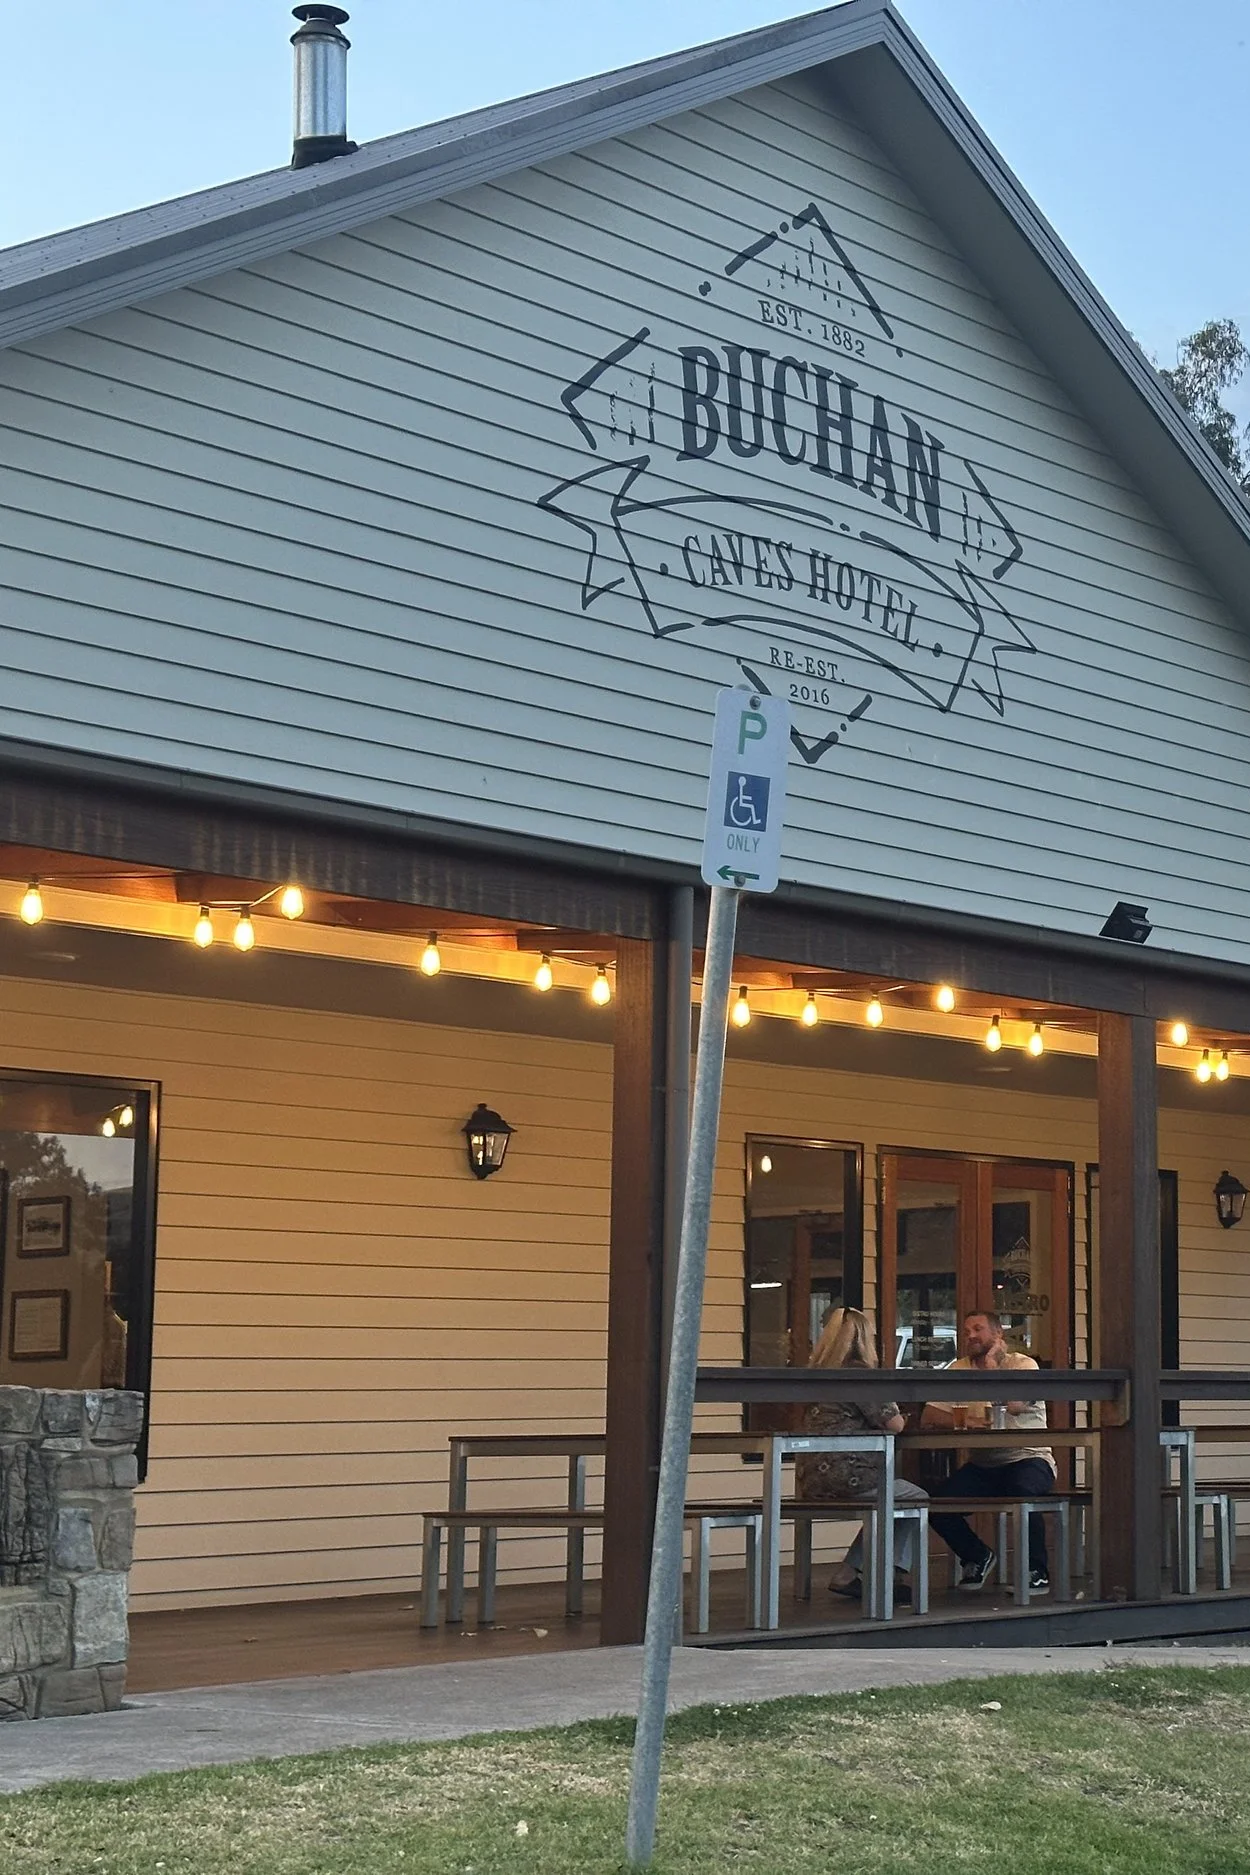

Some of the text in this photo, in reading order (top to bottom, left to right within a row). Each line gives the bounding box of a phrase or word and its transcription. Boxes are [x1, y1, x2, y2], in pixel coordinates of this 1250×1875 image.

[758, 300, 865, 357] EST. 1882
[677, 345, 945, 542] BUCHAN
[681, 534, 919, 652] CAVES HOTEL
[769, 646, 846, 683] RE-EST.
[789, 683, 830, 706] 2016
[738, 710, 767, 755] P
[726, 833, 761, 853] ONLY
